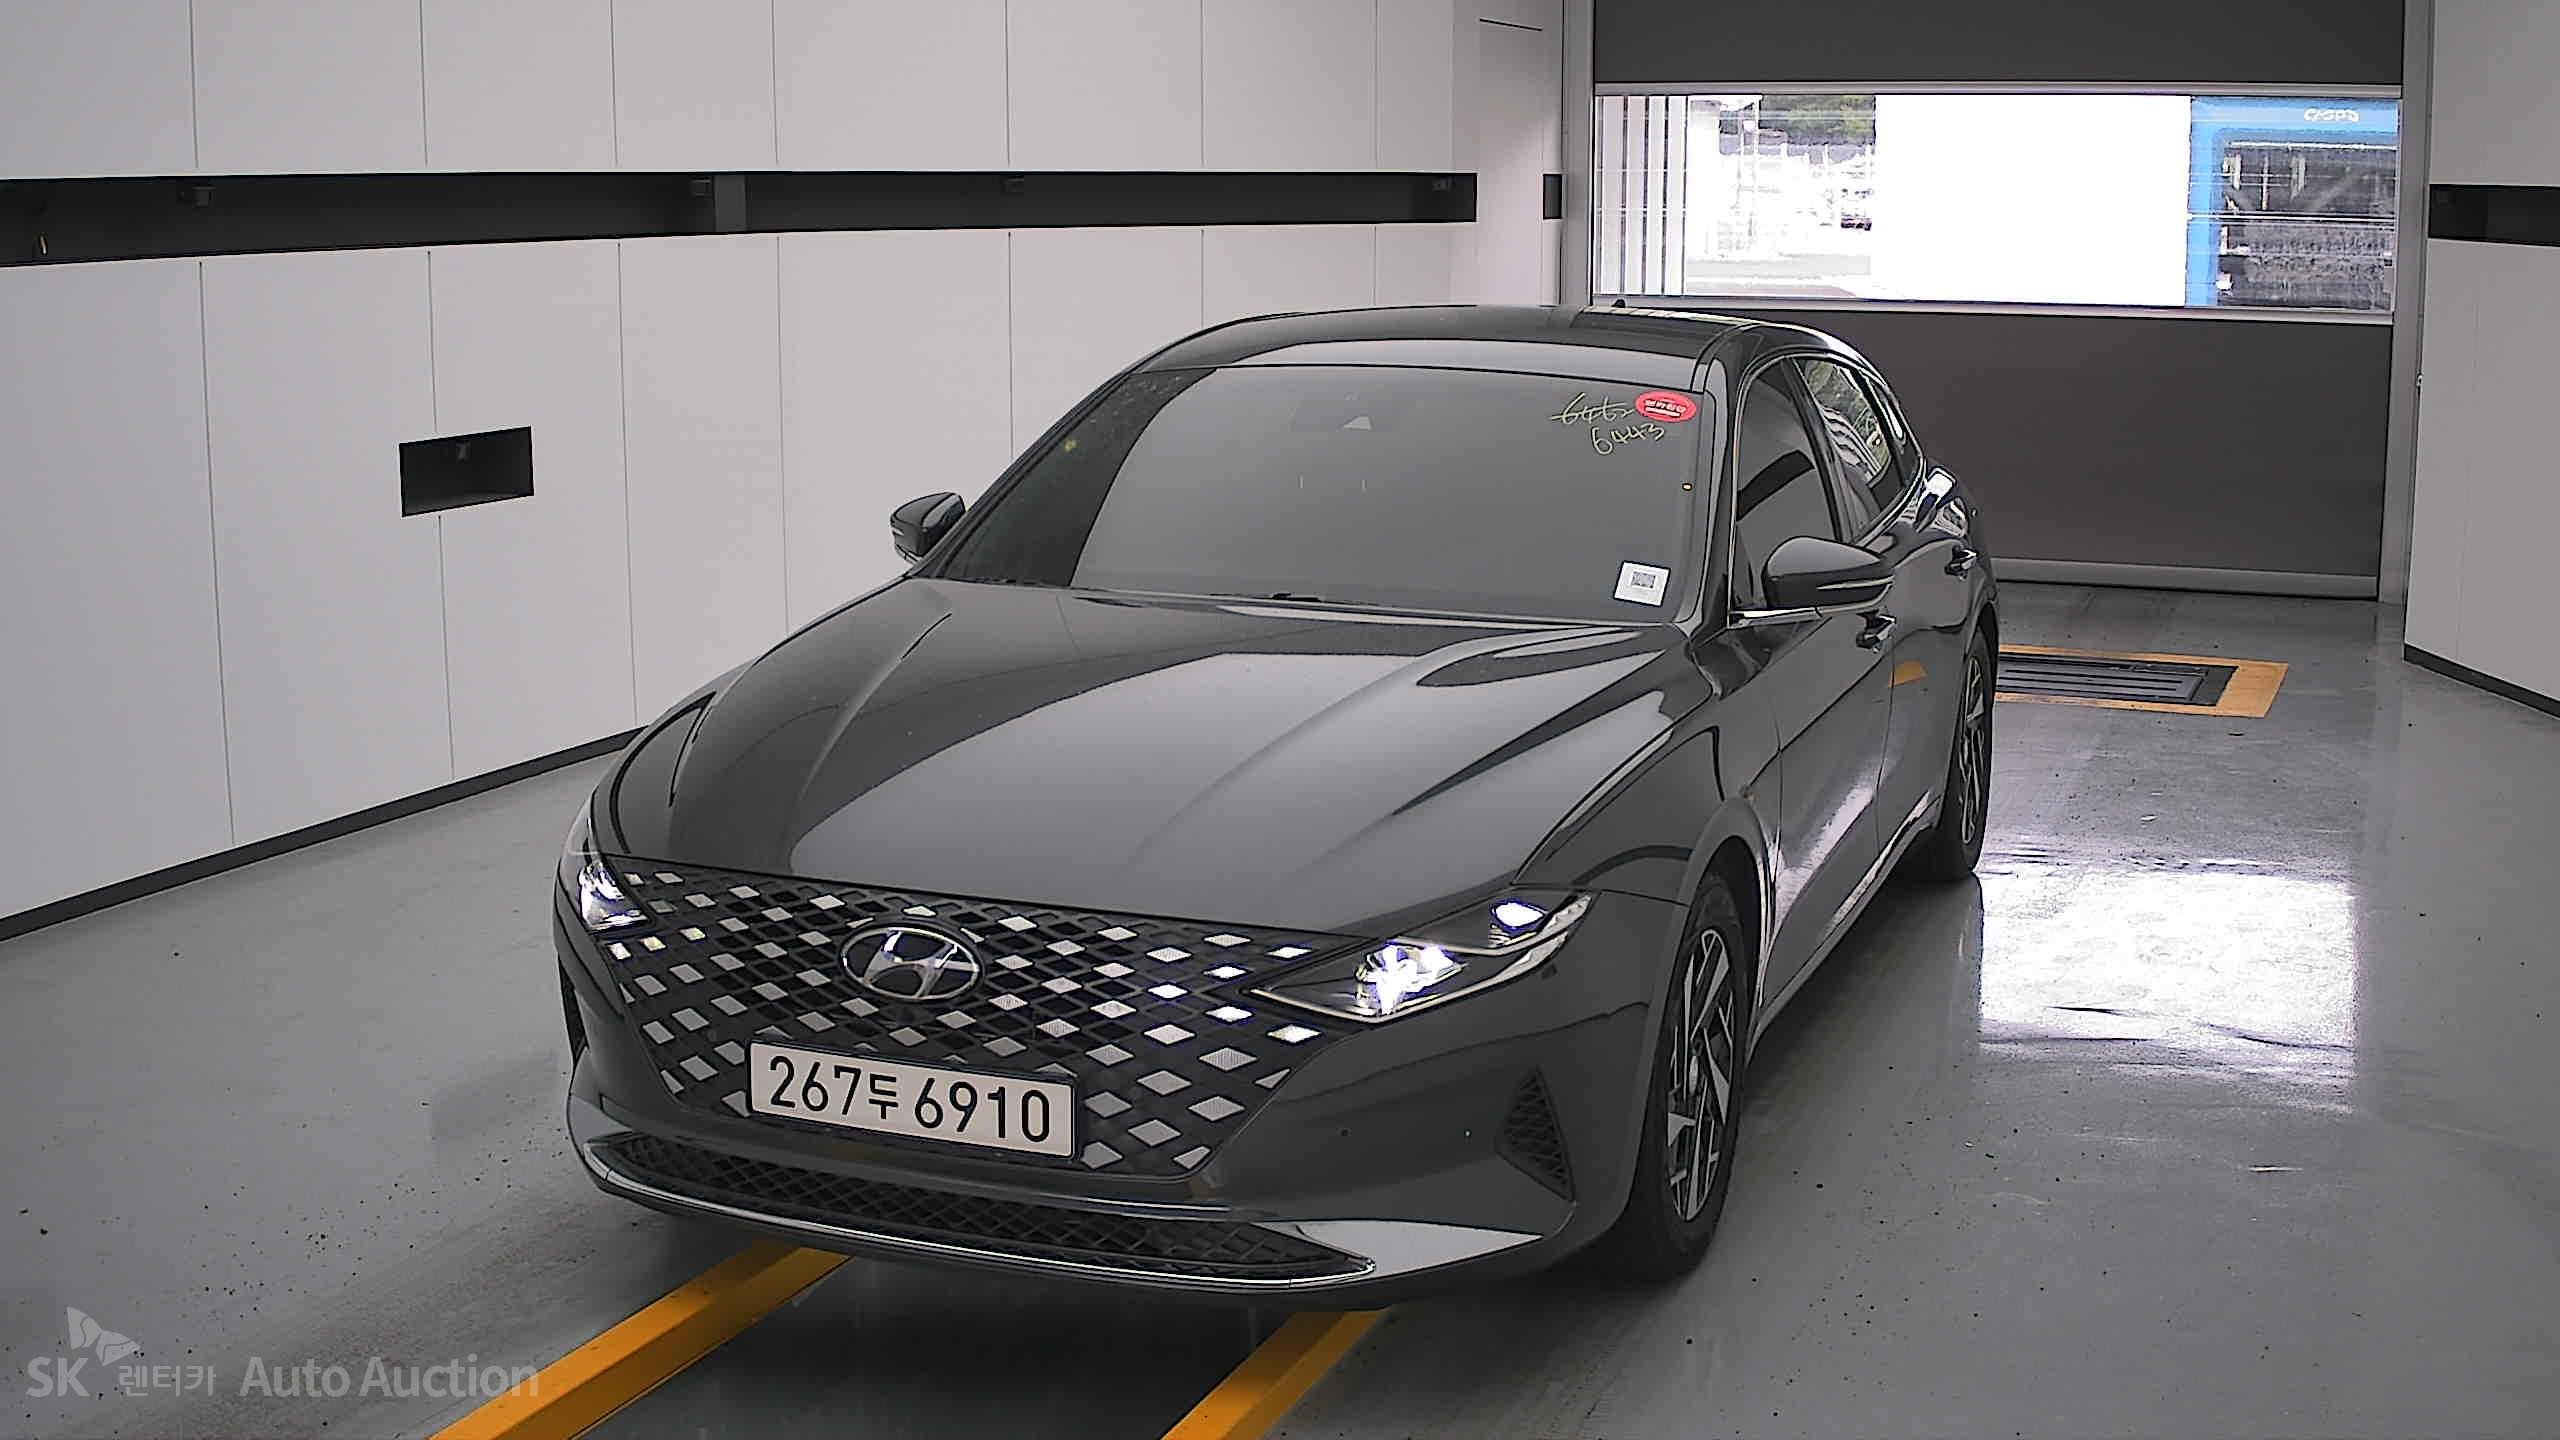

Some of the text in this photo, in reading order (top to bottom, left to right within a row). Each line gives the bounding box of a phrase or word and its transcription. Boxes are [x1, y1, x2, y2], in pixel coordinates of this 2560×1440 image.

[1591, 422, 1665, 455] 6443
[769, 1055, 1050, 1143] 267두 6910
